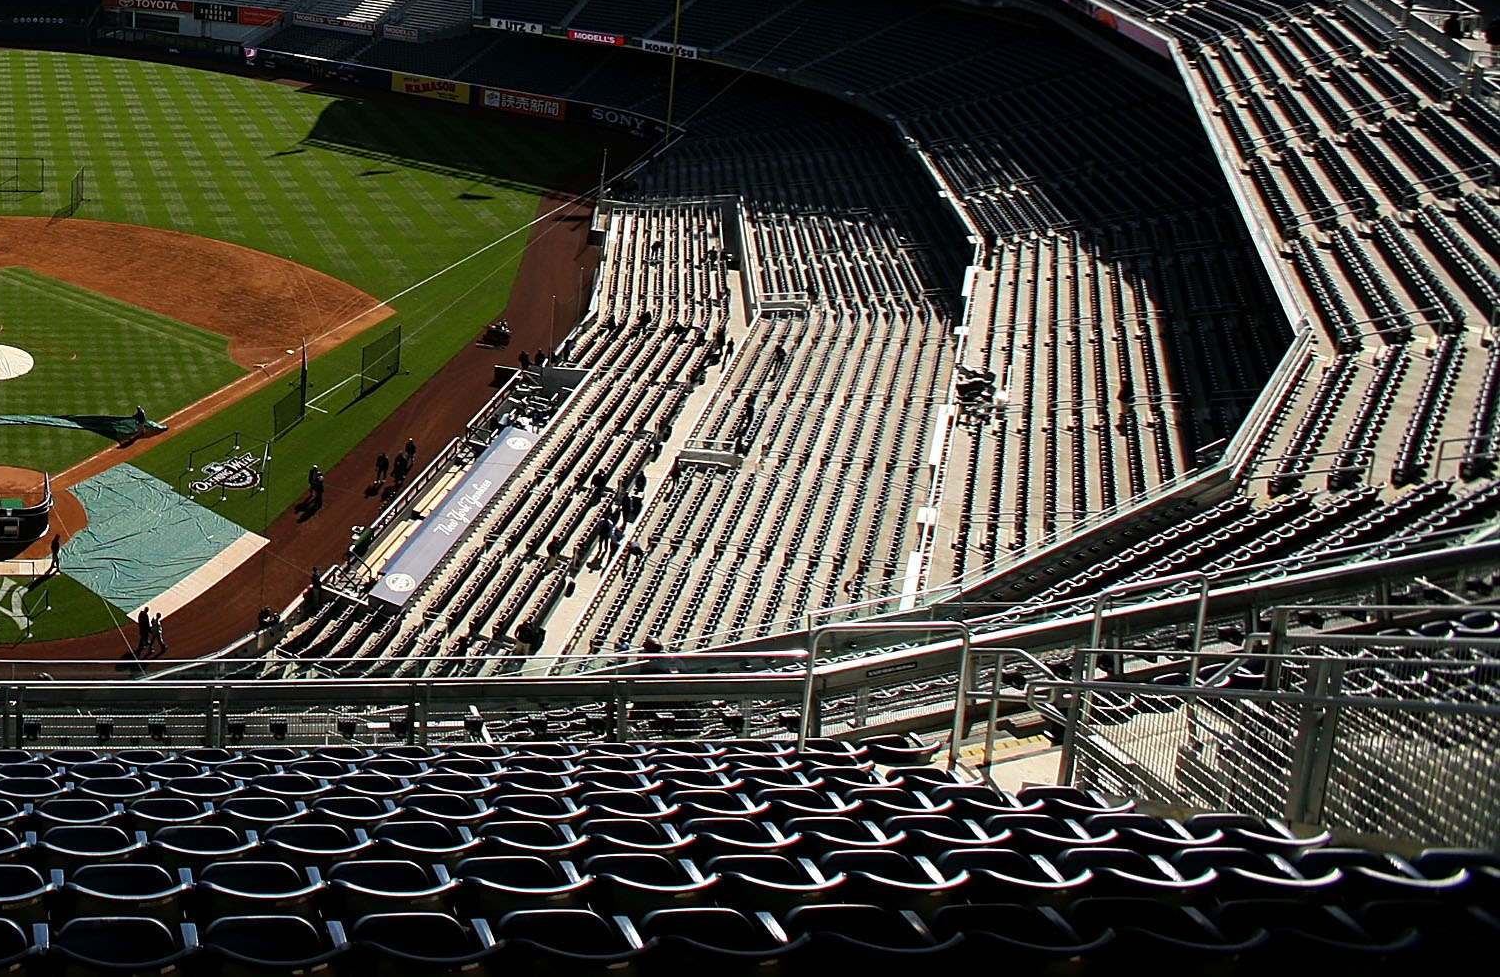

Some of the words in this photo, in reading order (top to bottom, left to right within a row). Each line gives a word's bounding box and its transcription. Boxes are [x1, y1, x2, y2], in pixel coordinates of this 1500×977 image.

[296, 13, 324, 23] MODELL'S
[385, 26, 417, 37] MODELL'S
[505, 21, 526, 33] UTZ
[573, 31, 616, 45] MODELL'S
[590, 106, 646, 130] SONY
[433, 518, 459, 536] New
[446, 501, 472, 524] York
[460, 479, 493, 508] Yankees
